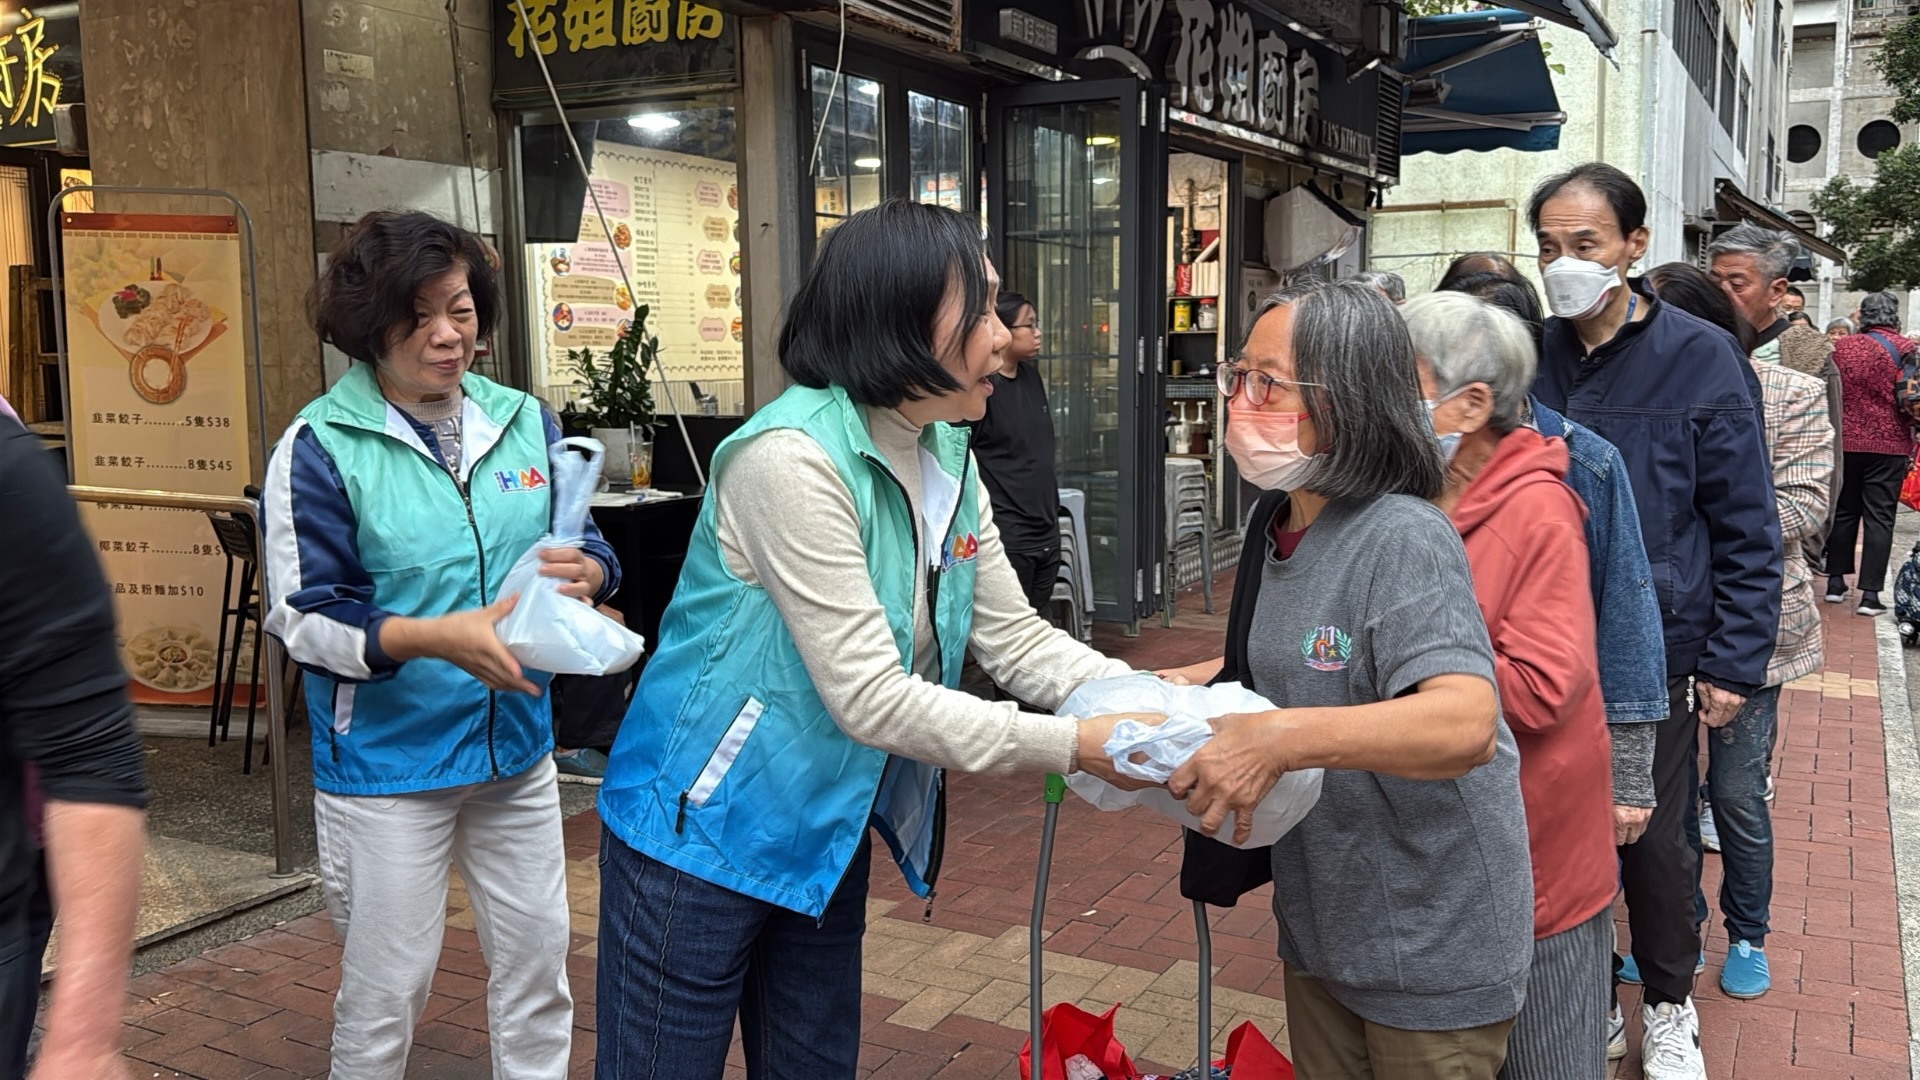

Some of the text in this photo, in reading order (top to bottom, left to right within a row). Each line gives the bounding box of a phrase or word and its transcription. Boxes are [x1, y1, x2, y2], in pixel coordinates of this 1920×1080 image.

[109, 583, 204, 597] 品及粉麵加$10
